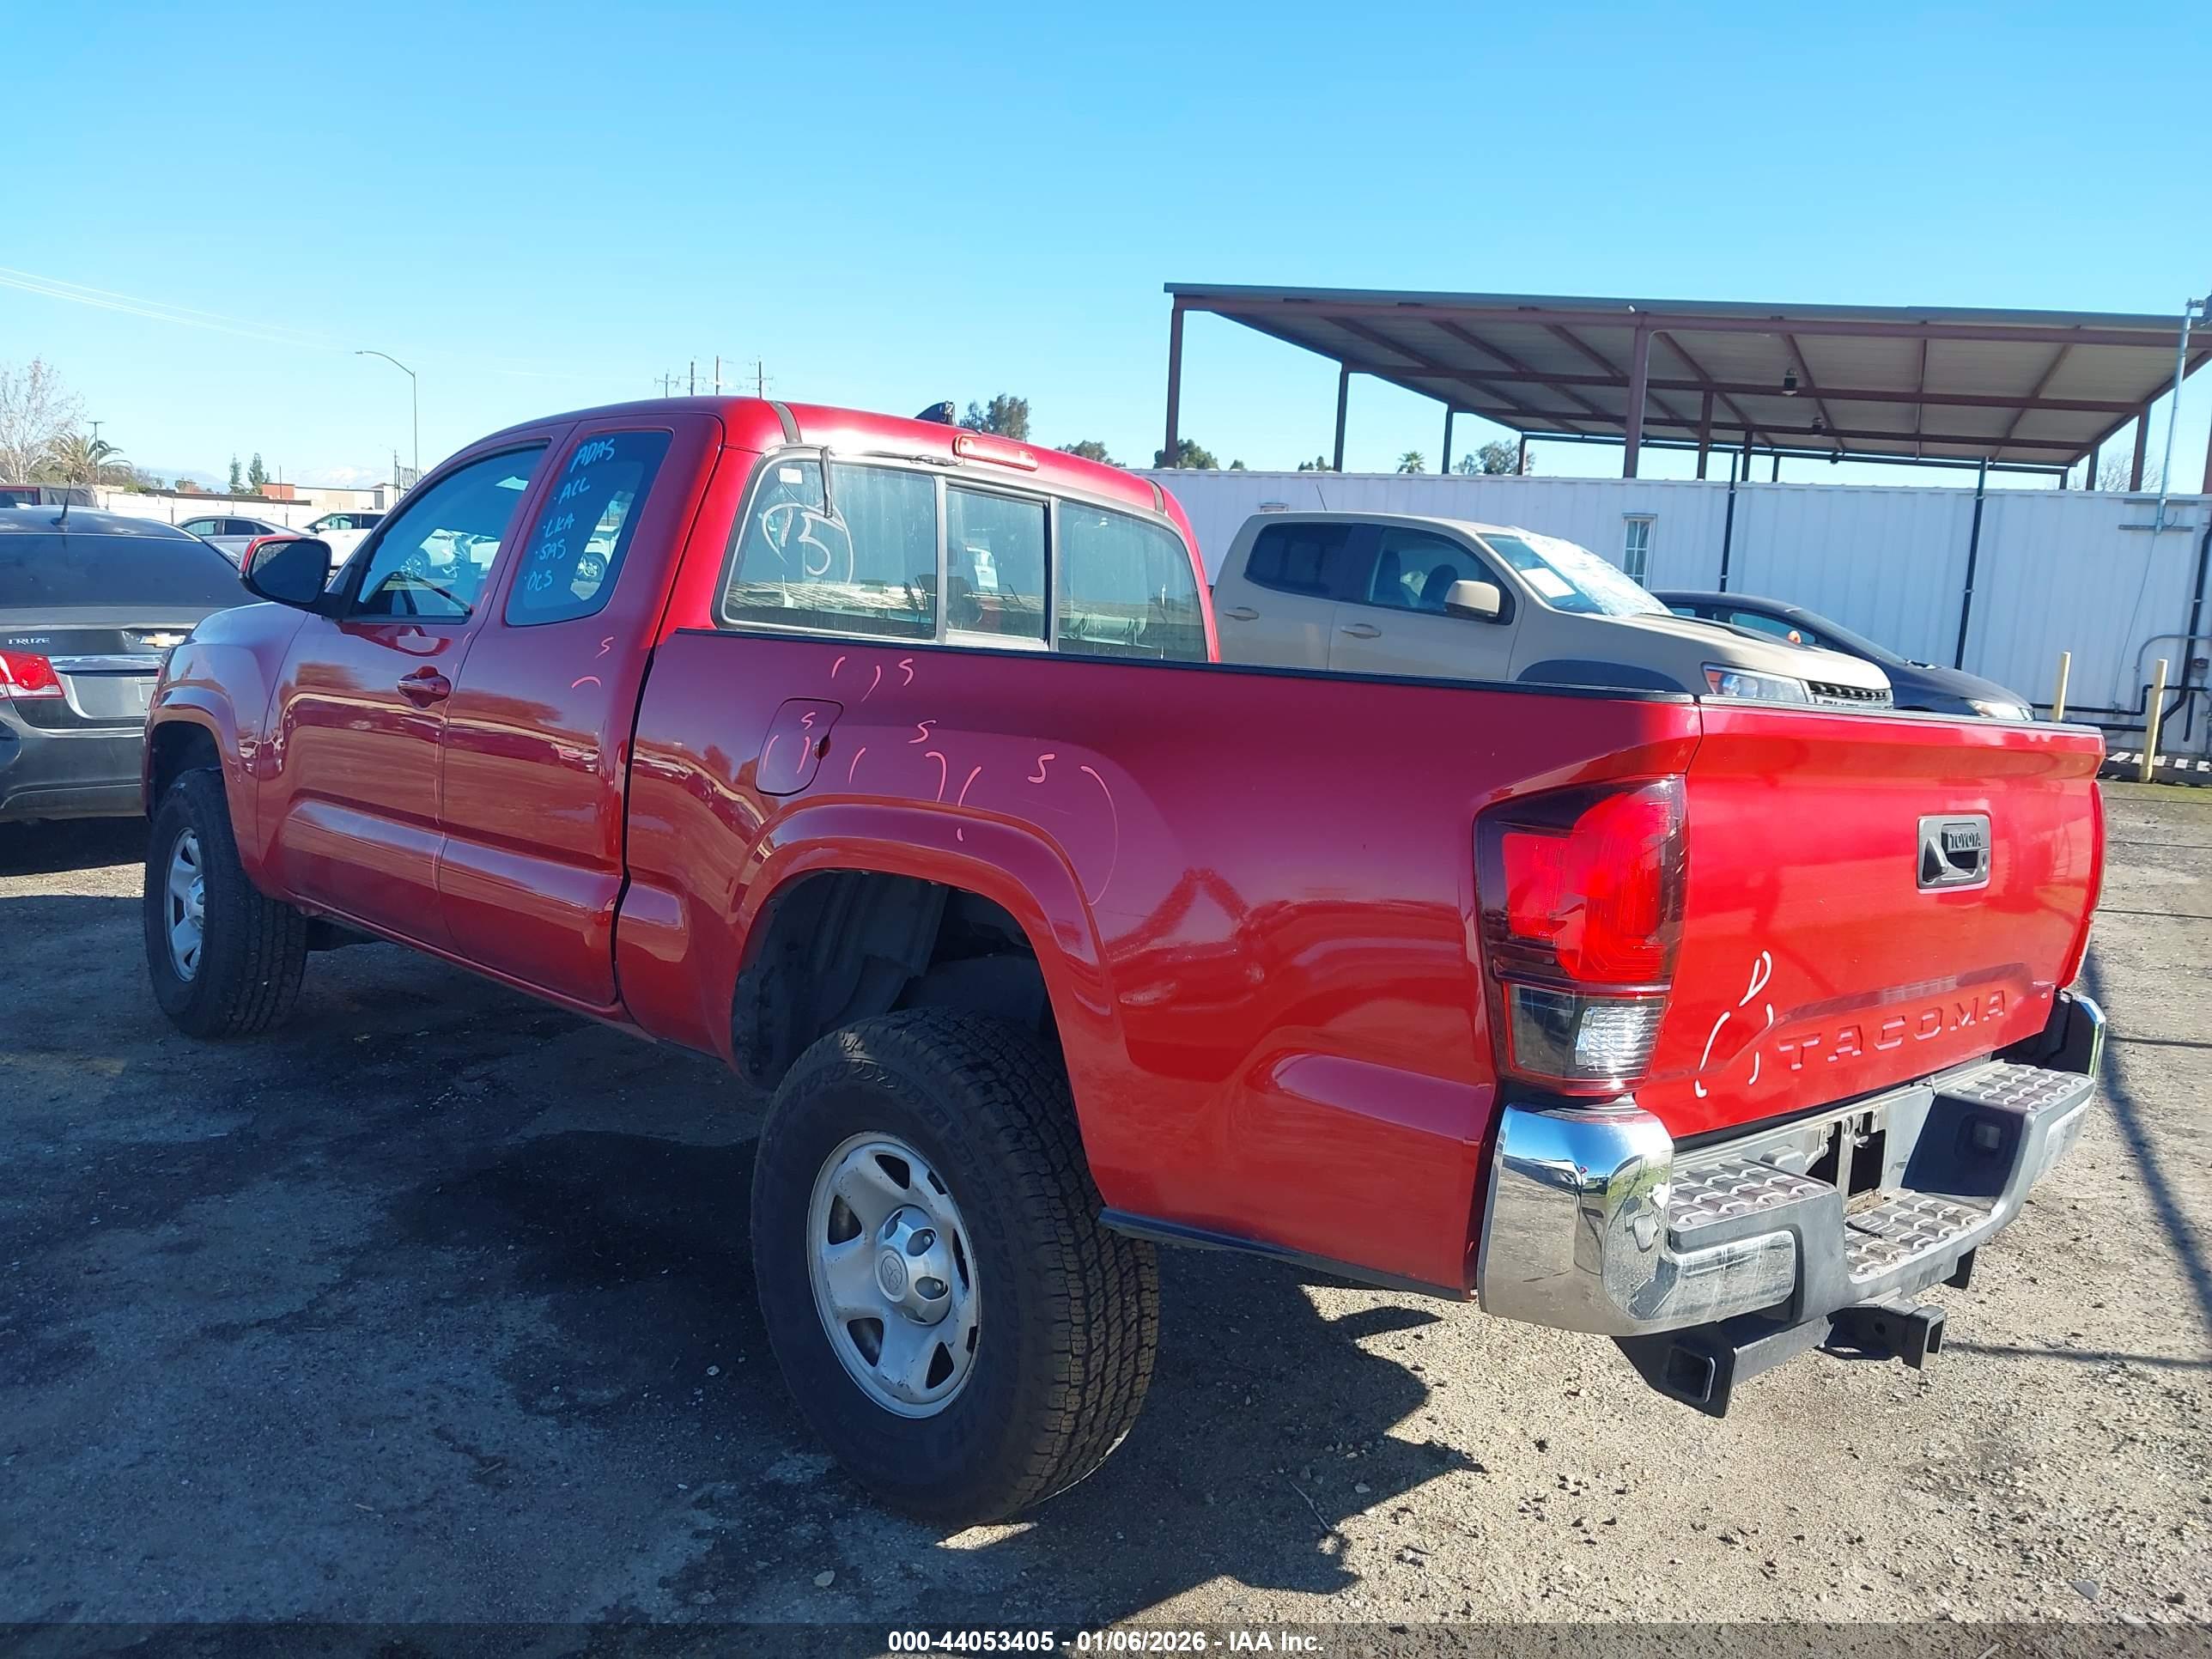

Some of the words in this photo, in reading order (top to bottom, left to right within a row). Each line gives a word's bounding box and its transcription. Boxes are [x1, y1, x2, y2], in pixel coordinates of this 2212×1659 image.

[570, 438, 615, 473] ADAS
[1949, 831, 1981, 849] TOYOTA
[1778, 989, 2006, 1071] TACOMA
